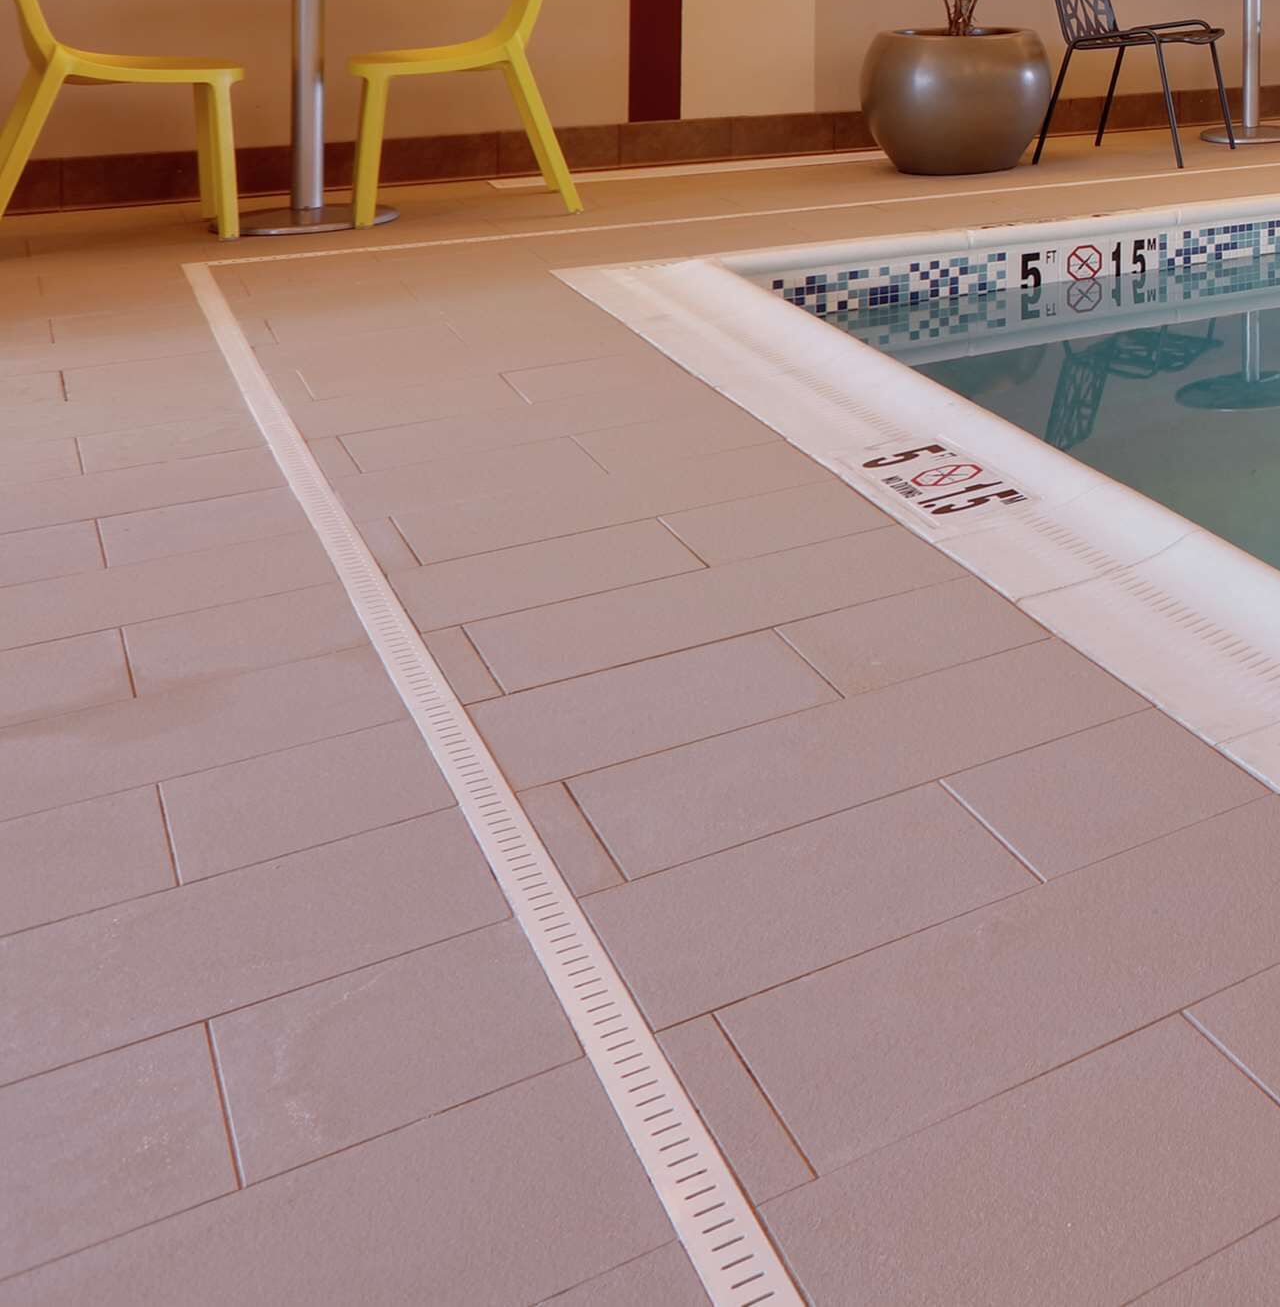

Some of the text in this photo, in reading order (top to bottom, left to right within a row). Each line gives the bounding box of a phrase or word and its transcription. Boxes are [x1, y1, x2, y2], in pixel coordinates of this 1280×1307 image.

[1020, 252, 1041, 289] 5
[1046, 250, 1057, 264] FT
[1147, 238, 1157, 251] M
[862, 444, 947, 468] 5
